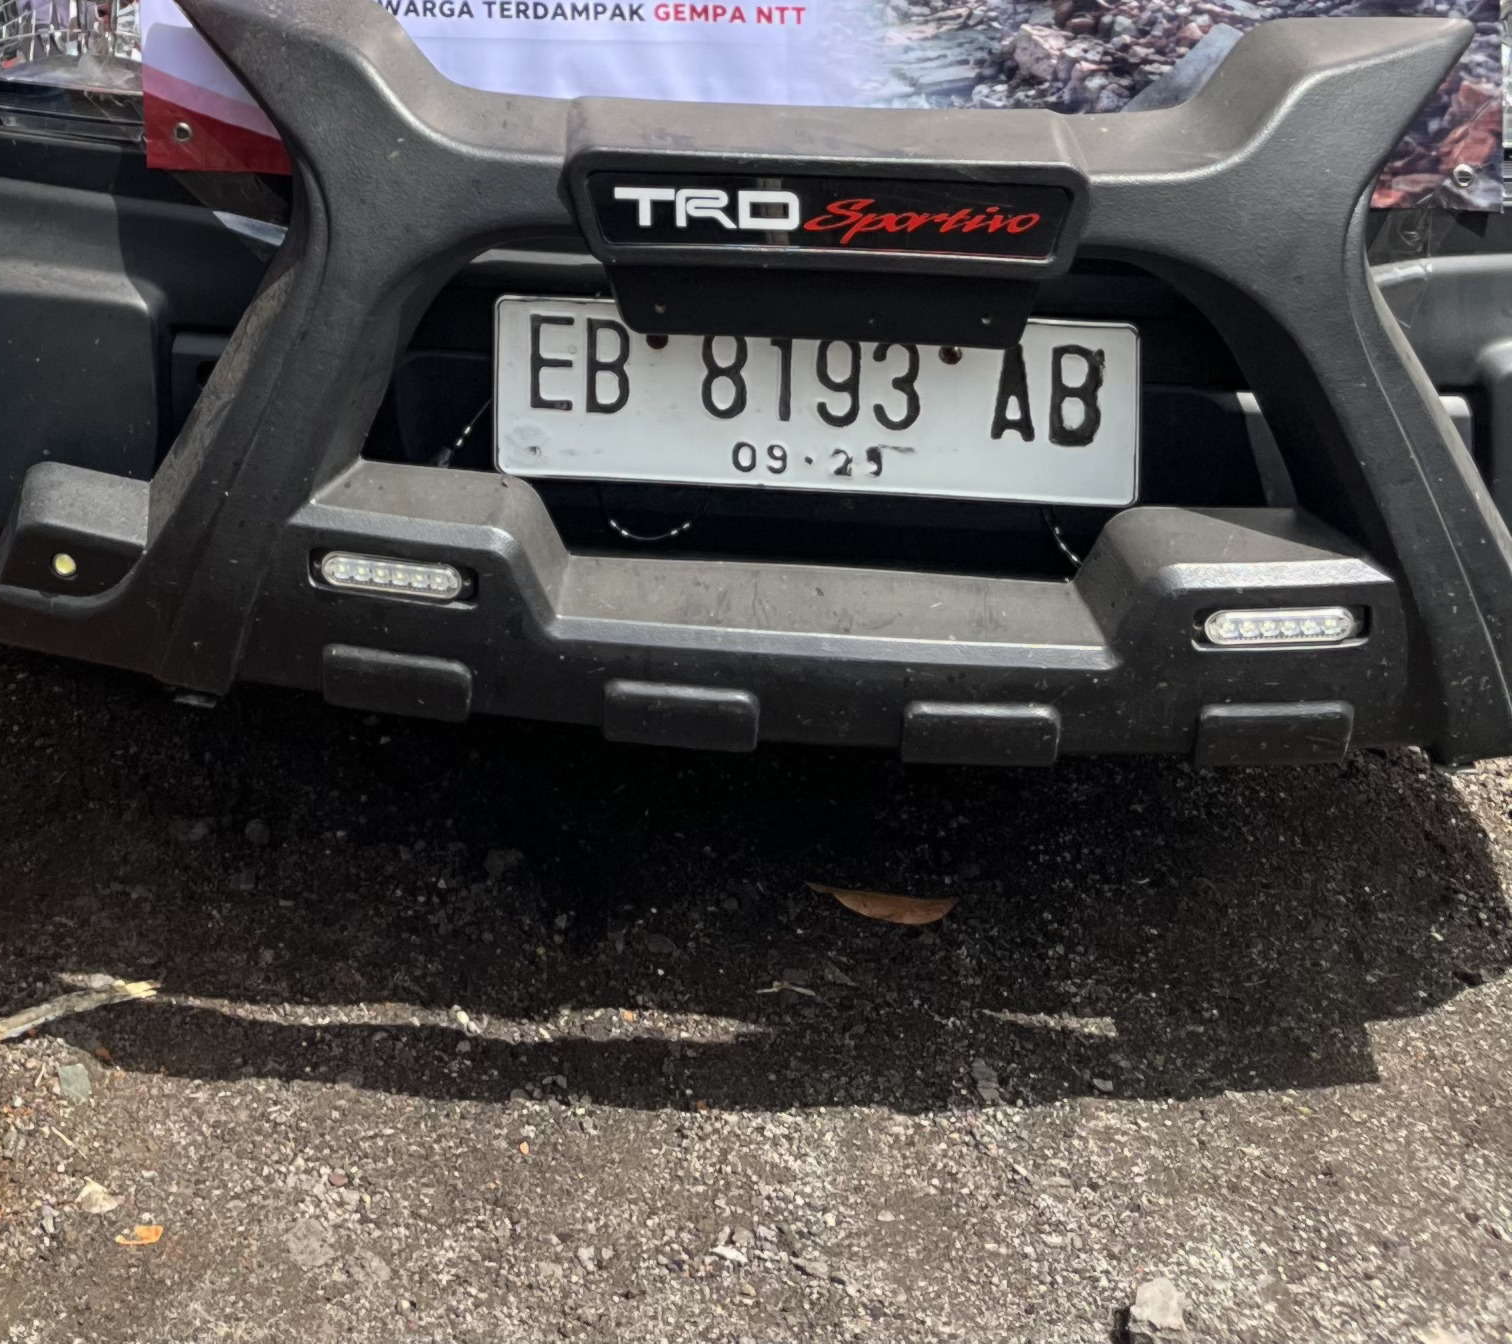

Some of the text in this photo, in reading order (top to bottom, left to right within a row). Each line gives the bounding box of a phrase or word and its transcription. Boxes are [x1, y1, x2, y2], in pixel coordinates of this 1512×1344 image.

[482, 0, 646, 22] TERDAMPAK
[653, 3, 747, 24] GEMPA
[756, 6, 807, 25] NTT
[613, 186, 1041, 245] TRD Sportivo
[529, 314, 1106, 448] EB 8193 AB
